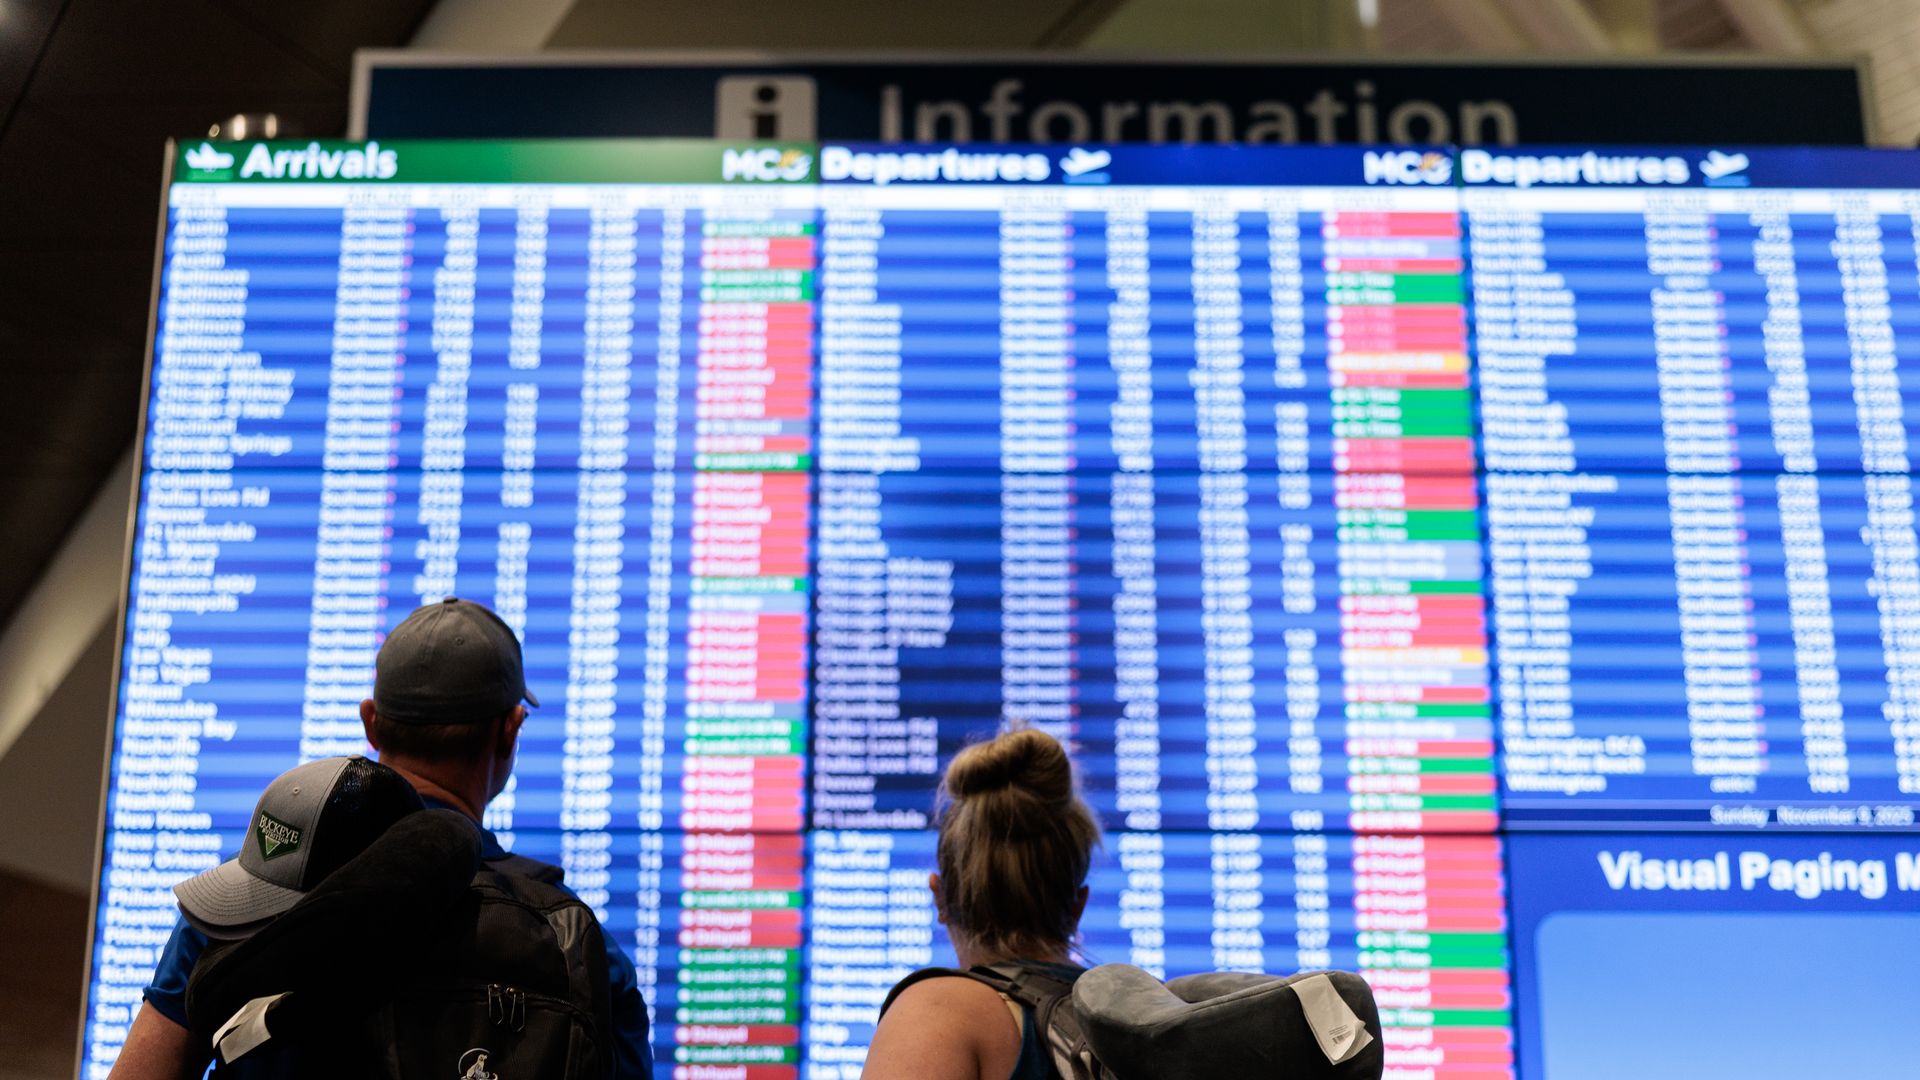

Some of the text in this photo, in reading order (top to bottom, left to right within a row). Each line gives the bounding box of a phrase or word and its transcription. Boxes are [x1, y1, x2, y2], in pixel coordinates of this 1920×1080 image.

[879, 79, 1520, 144] Information
[240, 142, 399, 180] Arrivals
[722, 148, 812, 182] MCO
[820, 147, 1051, 186] Departures
[1363, 151, 1453, 184] MCO
[1460, 150, 1690, 187] Departures
[259, 814, 299, 844] BUCKEYE
[1776, 805, 1856, 827] November
[1598, 850, 1730, 891] Visual
[1738, 850, 1888, 900] Paging
